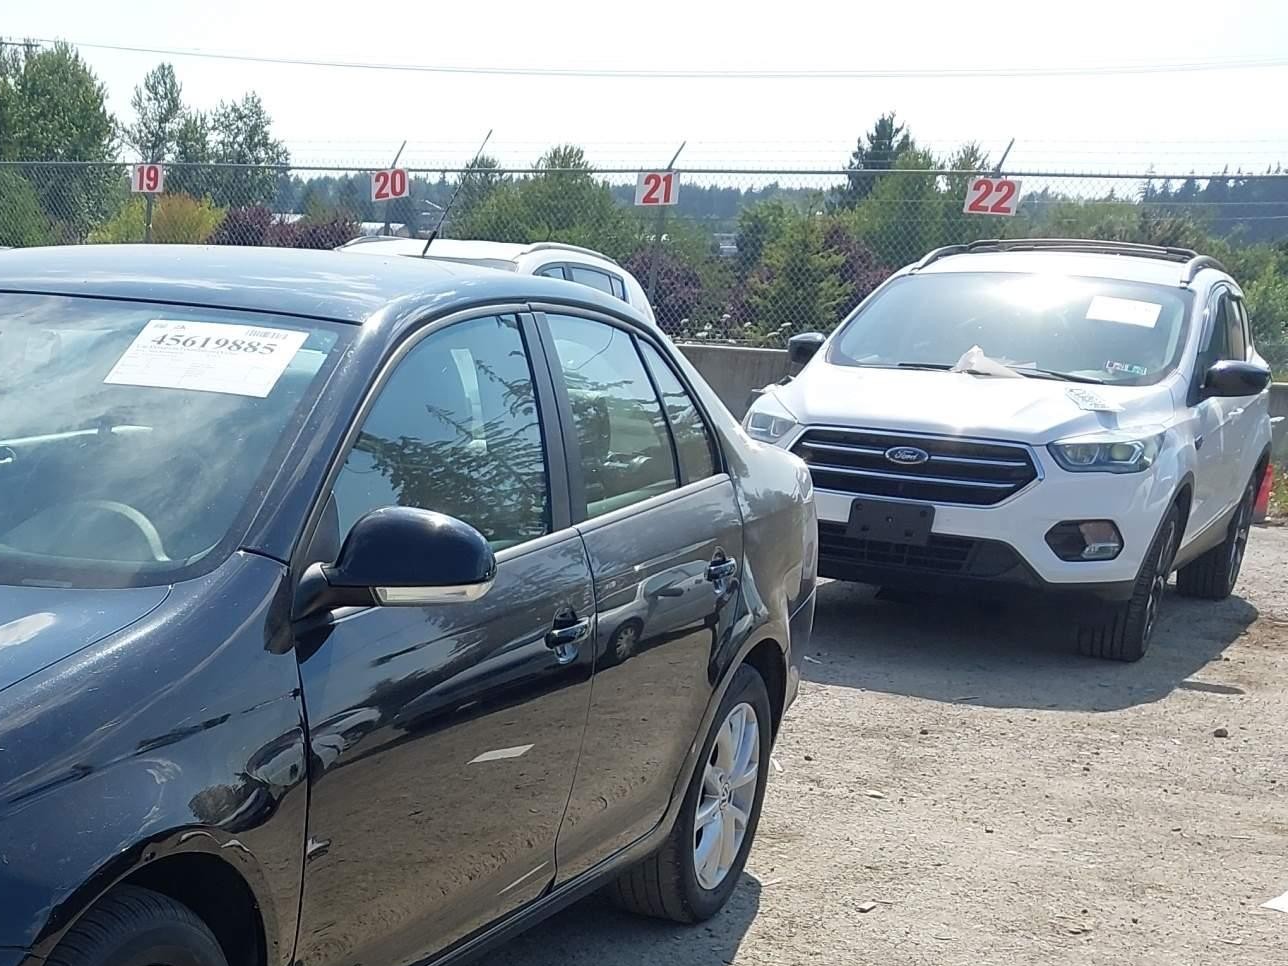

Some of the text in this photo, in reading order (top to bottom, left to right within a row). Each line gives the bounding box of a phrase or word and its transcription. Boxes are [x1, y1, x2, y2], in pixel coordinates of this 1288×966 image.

[136, 165, 160, 192] 19
[375, 169, 407, 200] 20
[642, 173, 673, 205] 21
[968, 177, 1016, 215] 22
[152, 332, 278, 356] 45619885
